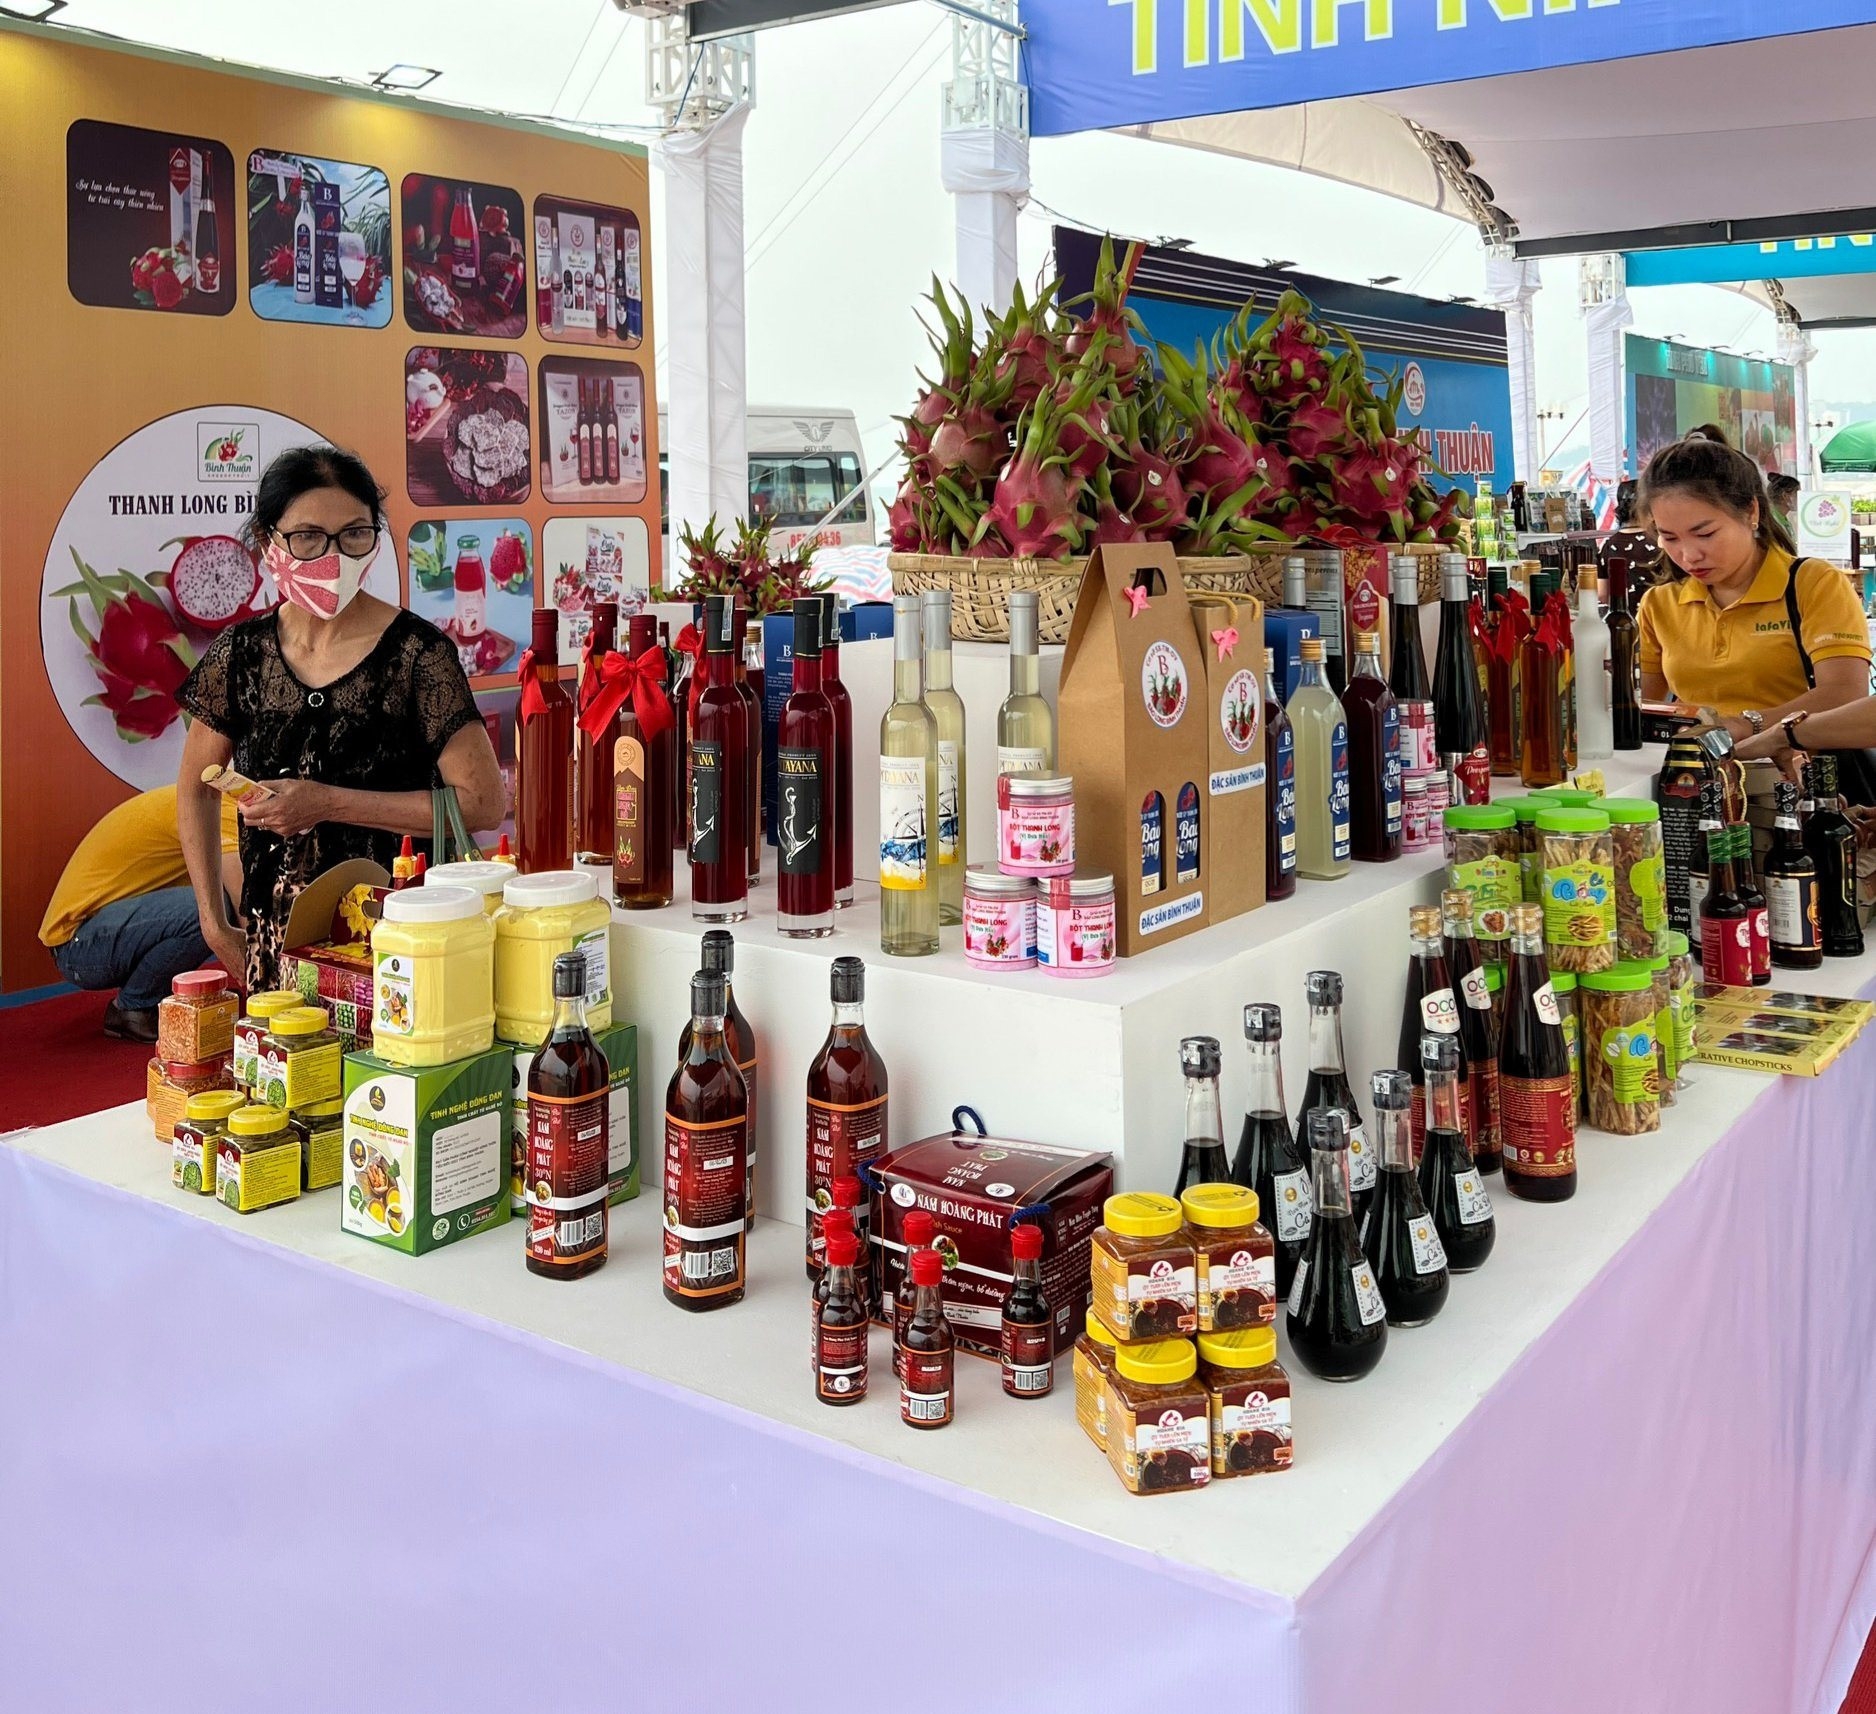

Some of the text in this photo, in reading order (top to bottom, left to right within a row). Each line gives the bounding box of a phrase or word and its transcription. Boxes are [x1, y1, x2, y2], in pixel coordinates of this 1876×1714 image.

[251, 156, 264, 171] B
[1435, 421, 1495, 483] THUẬN
[108, 495, 174, 515] THANH
[181, 495, 228, 515] LONG
[1158, 655, 1169, 676] B
[1240, 682, 1247, 702] B
[1338, 726, 1345, 739] B
[1211, 778, 1224, 792] ĐẶC
[1237, 772, 1249, 786] BÌNH
[1012, 808, 1019, 819] B
[1072, 909, 1082, 920] B
[1141, 897, 1201, 931] ĐẶC SẢN BÌNH THUẬN
[1735, 1054, 1793, 1072] CHOPSTICKS
[917, 1194, 1004, 1229] NAM HOÀNG PHÁT
